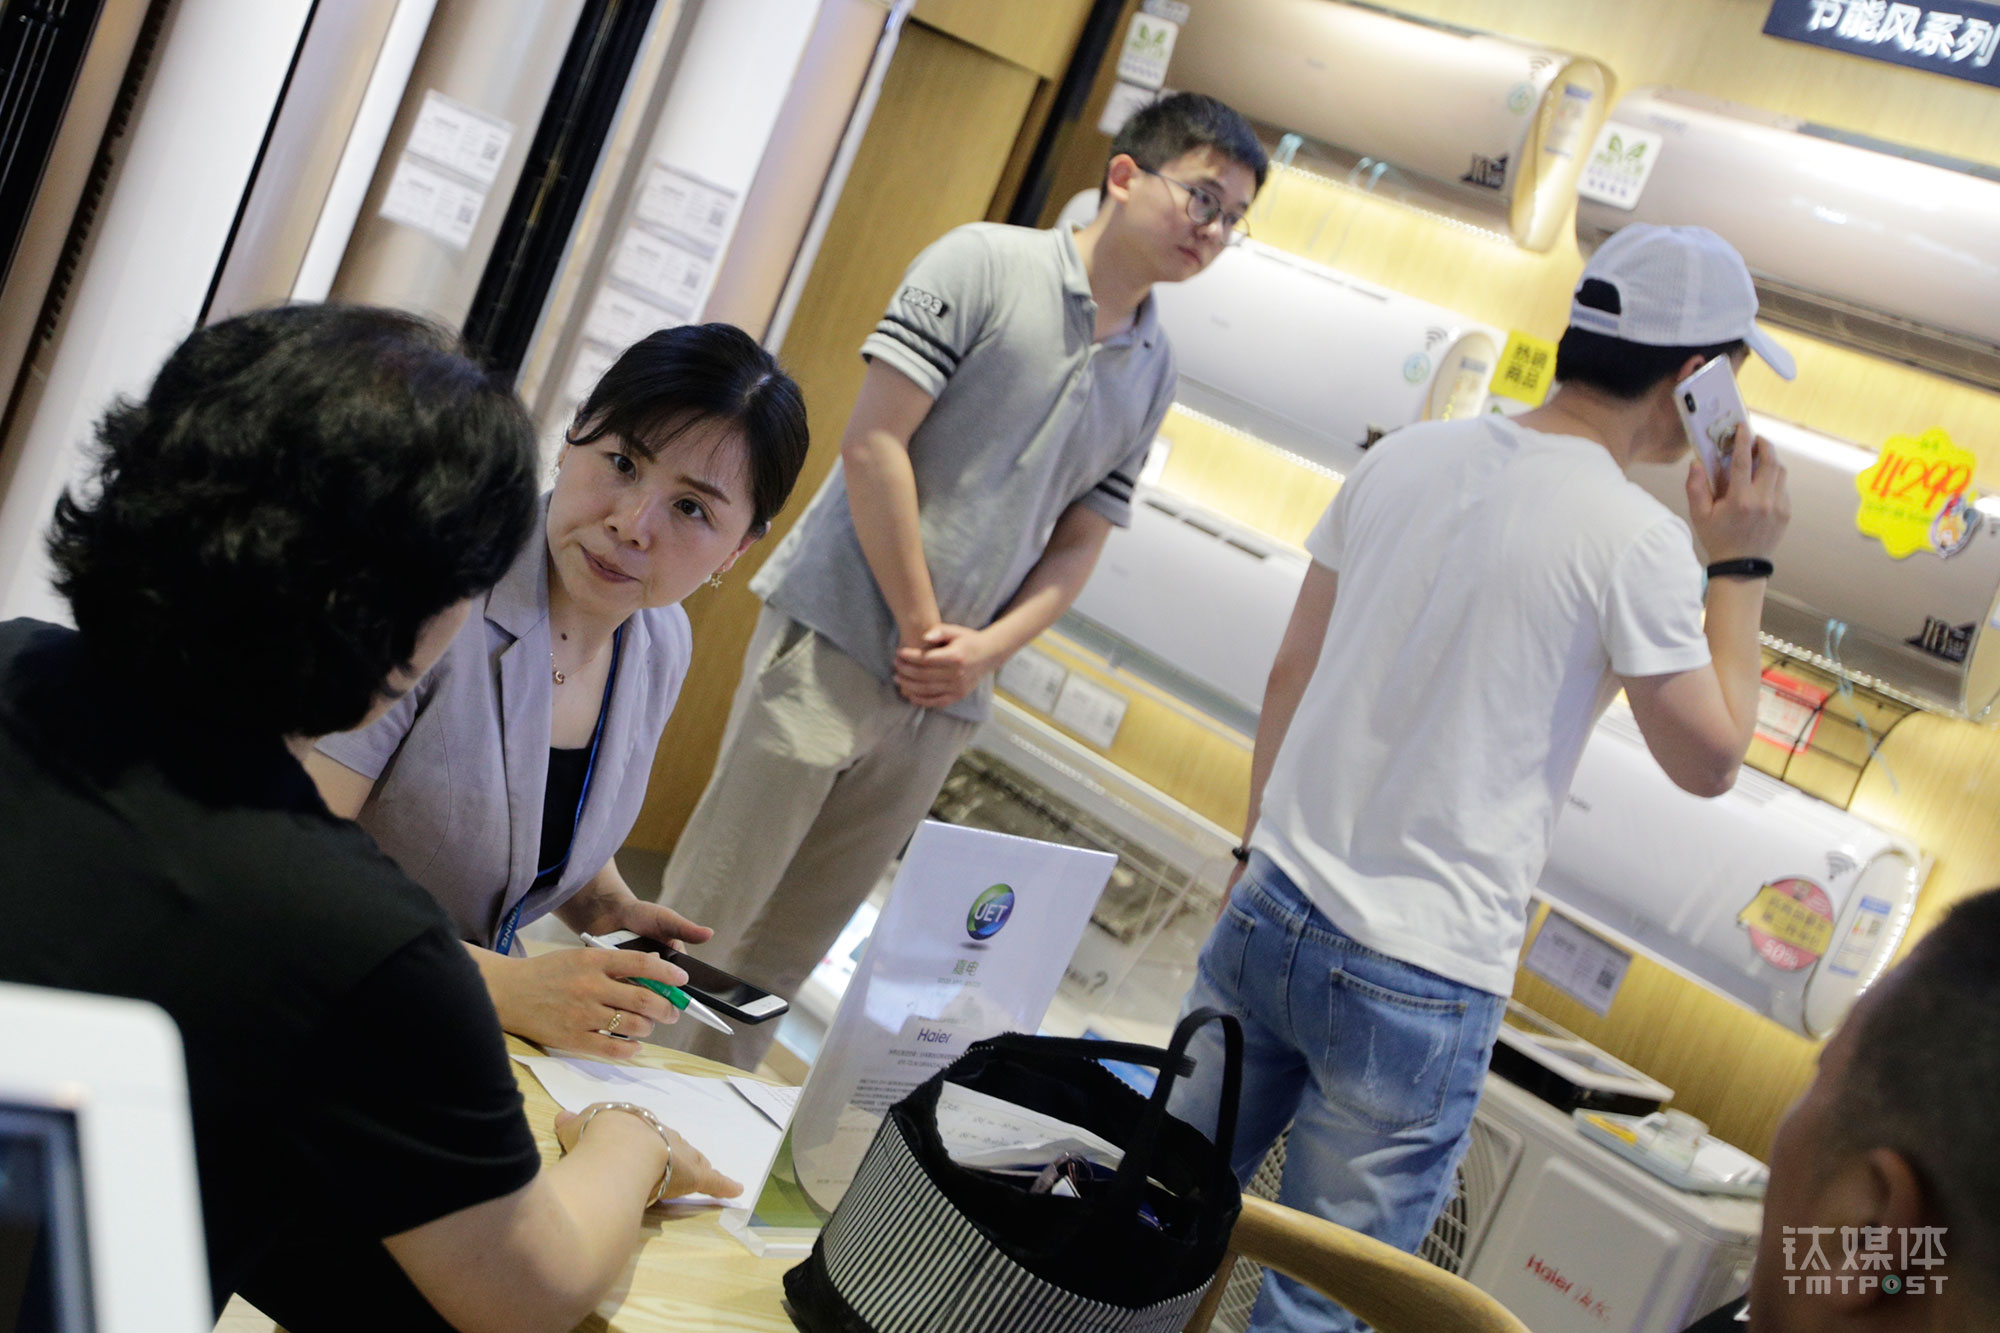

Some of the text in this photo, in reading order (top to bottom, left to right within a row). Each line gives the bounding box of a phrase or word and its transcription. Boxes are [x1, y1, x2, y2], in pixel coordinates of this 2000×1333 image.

[1806, 0, 2000, 67] 节能风系列
[974, 902, 1009, 923] UET
[916, 1027, 953, 1044] Haier
[1526, 1252, 1574, 1293] Haier
